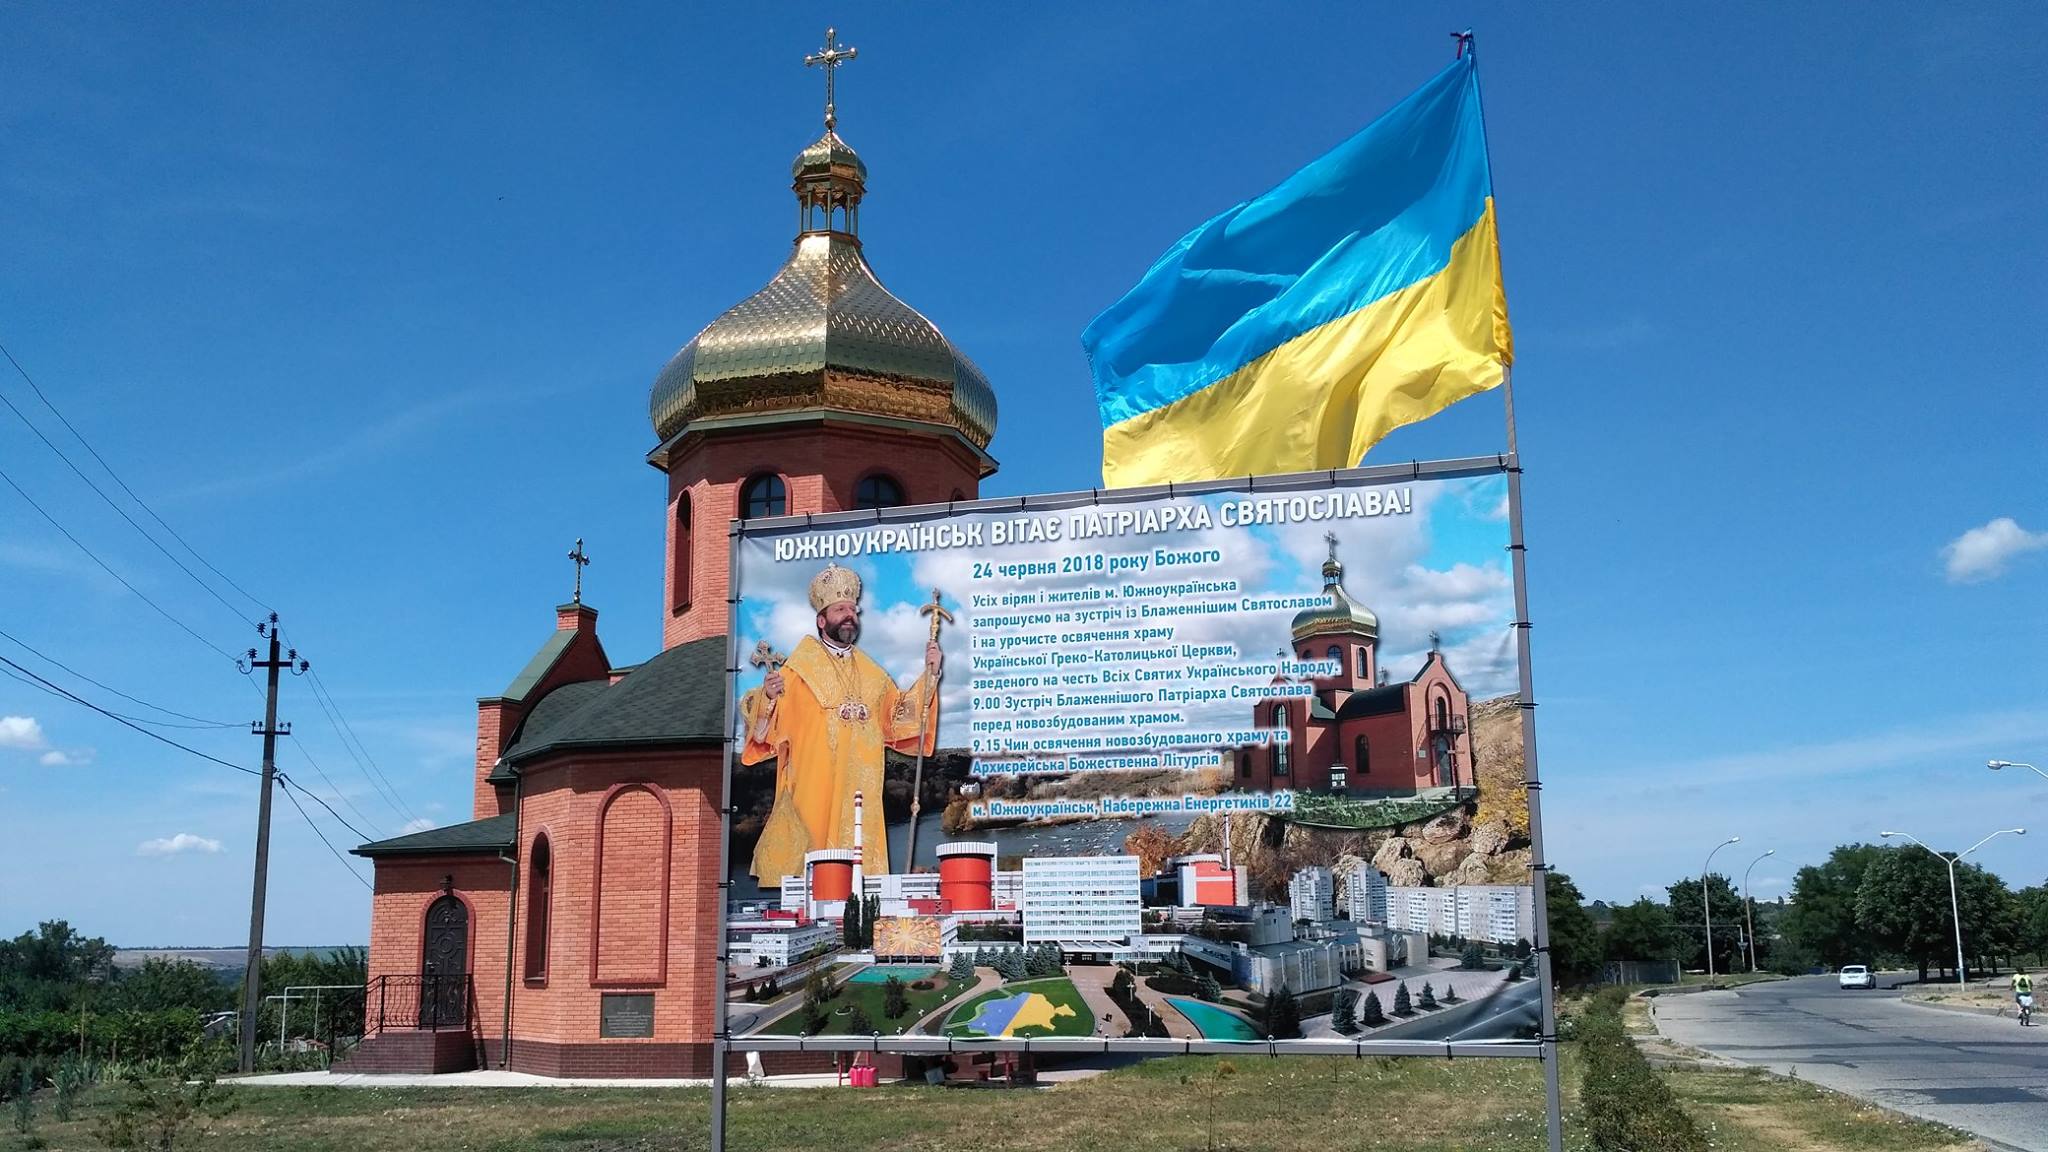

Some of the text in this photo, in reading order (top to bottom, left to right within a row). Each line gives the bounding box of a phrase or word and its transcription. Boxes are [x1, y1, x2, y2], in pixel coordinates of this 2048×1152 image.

[775, 487, 1411, 561] ЮЖНОУКРАЇНСЬК ВІТАЄ ПАТРІАРХА СВЯТОСЛАВА!
[973, 550, 1221, 580] 24 червня 2018 року Божого
[973, 580, 1236, 608] Усіх вірян і жителів м. Южноукраїнська
[973, 596, 1332, 629] запрошуємо на зустріч із Блаженнішим Святославом
[973, 627, 1174, 650] і на урочисте освячення храму
[973, 645, 1237, 671] Української Греко-Католицької Церкви,
[973, 660, 1339, 691] зведеного на честь Всіх Святих Українського Народу.
[973, 683, 1312, 711] 9.00 Зустріч Блаженнішого Патріарха Святослава
[973, 712, 1184, 734] перед новозбудованим храмом.
[973, 730, 1289, 752] 9.15 Чин освячення новозбудованого храму та
[973, 751, 1219, 775] Архиєрейська Божественна Літургія
[973, 794, 1292, 818] м. Южноукраїнськ, Набережна Енергетиків 22
